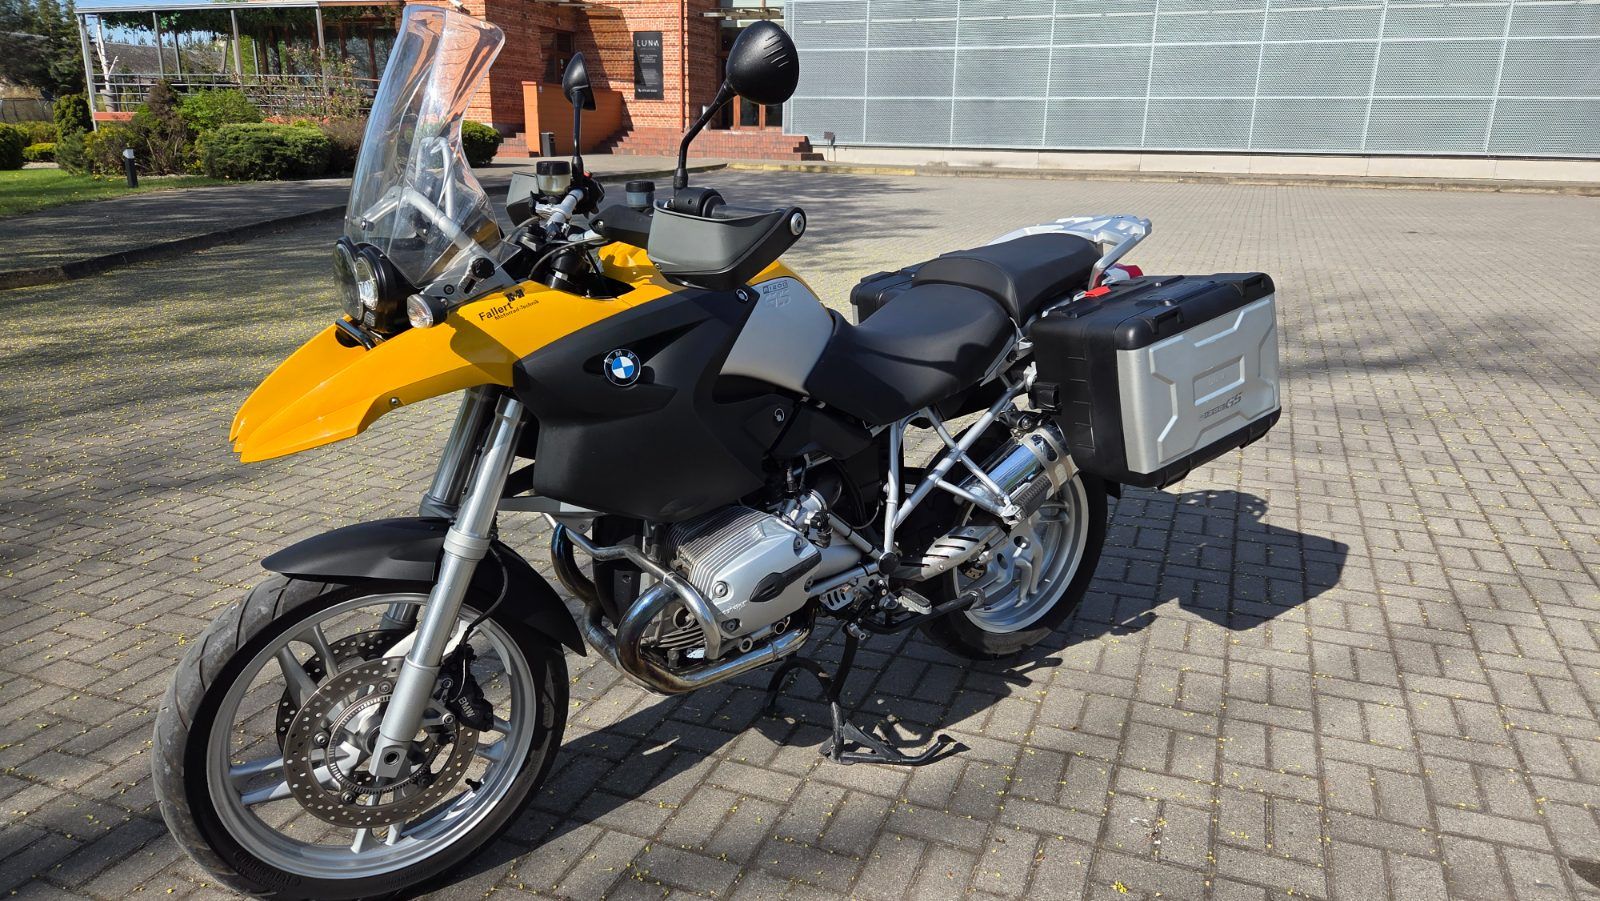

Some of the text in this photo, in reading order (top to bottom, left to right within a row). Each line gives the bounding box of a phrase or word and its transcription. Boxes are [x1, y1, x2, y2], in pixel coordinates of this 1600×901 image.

[636, 39, 660, 47] LUNA
[478, 302, 513, 321] Fallert
[458, 696, 476, 718] BMW
